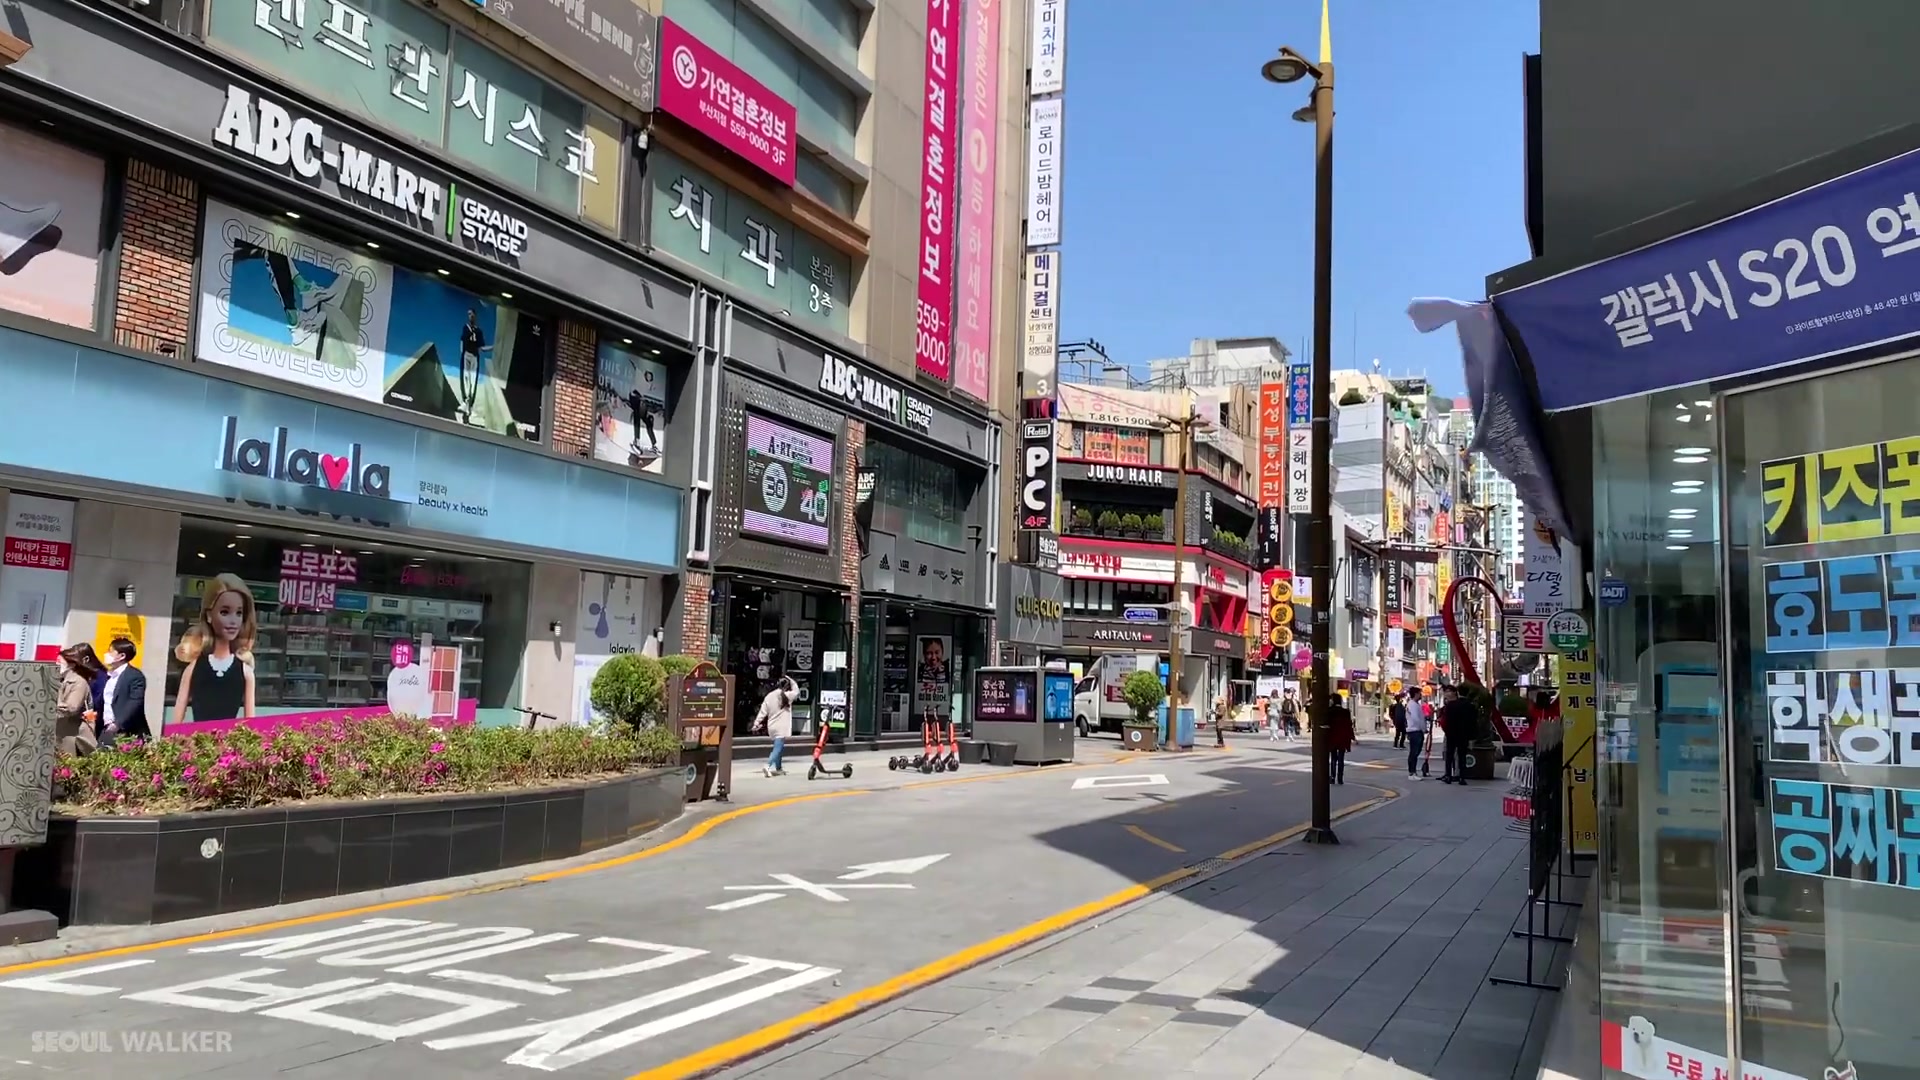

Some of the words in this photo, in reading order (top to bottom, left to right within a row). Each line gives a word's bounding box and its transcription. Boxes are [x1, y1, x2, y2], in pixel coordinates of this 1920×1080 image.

[700, 66, 787, 146] 가연결혼정보
[212, 85, 441, 222] ABC-MART
[730, 120, 770, 155] 559-0000
[771, 146, 787, 166] 3F
[1036, 125, 1054, 222] 로이드밤헤어
[462, 197, 528, 240] GRAND
[669, 176, 784, 288] 치과
[462, 219, 523, 257] STAGE
[1034, 254, 1050, 307] 메디컬
[1601, 259, 1738, 348] 갤럭시
[1738, 226, 1857, 307] S20
[1030, 307, 1052, 319] 센터
[213, 322, 368, 389] OZWEEGO
[820, 353, 901, 415] ABC-MART
[906, 410, 931, 428] STAGE
[907, 396, 933, 417] GRAND
[419, 481, 448, 496] 랄라블라
[858, 473, 875, 483] ABC
[1087, 464, 1124, 483] JUNO
[1129, 466, 1162, 484] HAIR
[1293, 451, 1309, 502] 헤어짱
[418, 494, 451, 512] beauty
[461, 502, 488, 517] health
[1024, 515, 1047, 527] 4F
[5, 553, 39, 564] 인텐시브
[280, 549, 357, 582] 프로포즈
[279, 578, 336, 609] 에디션
[1093, 629, 1141, 641] ARITAUM
[1522, 621, 1544, 649] 철
